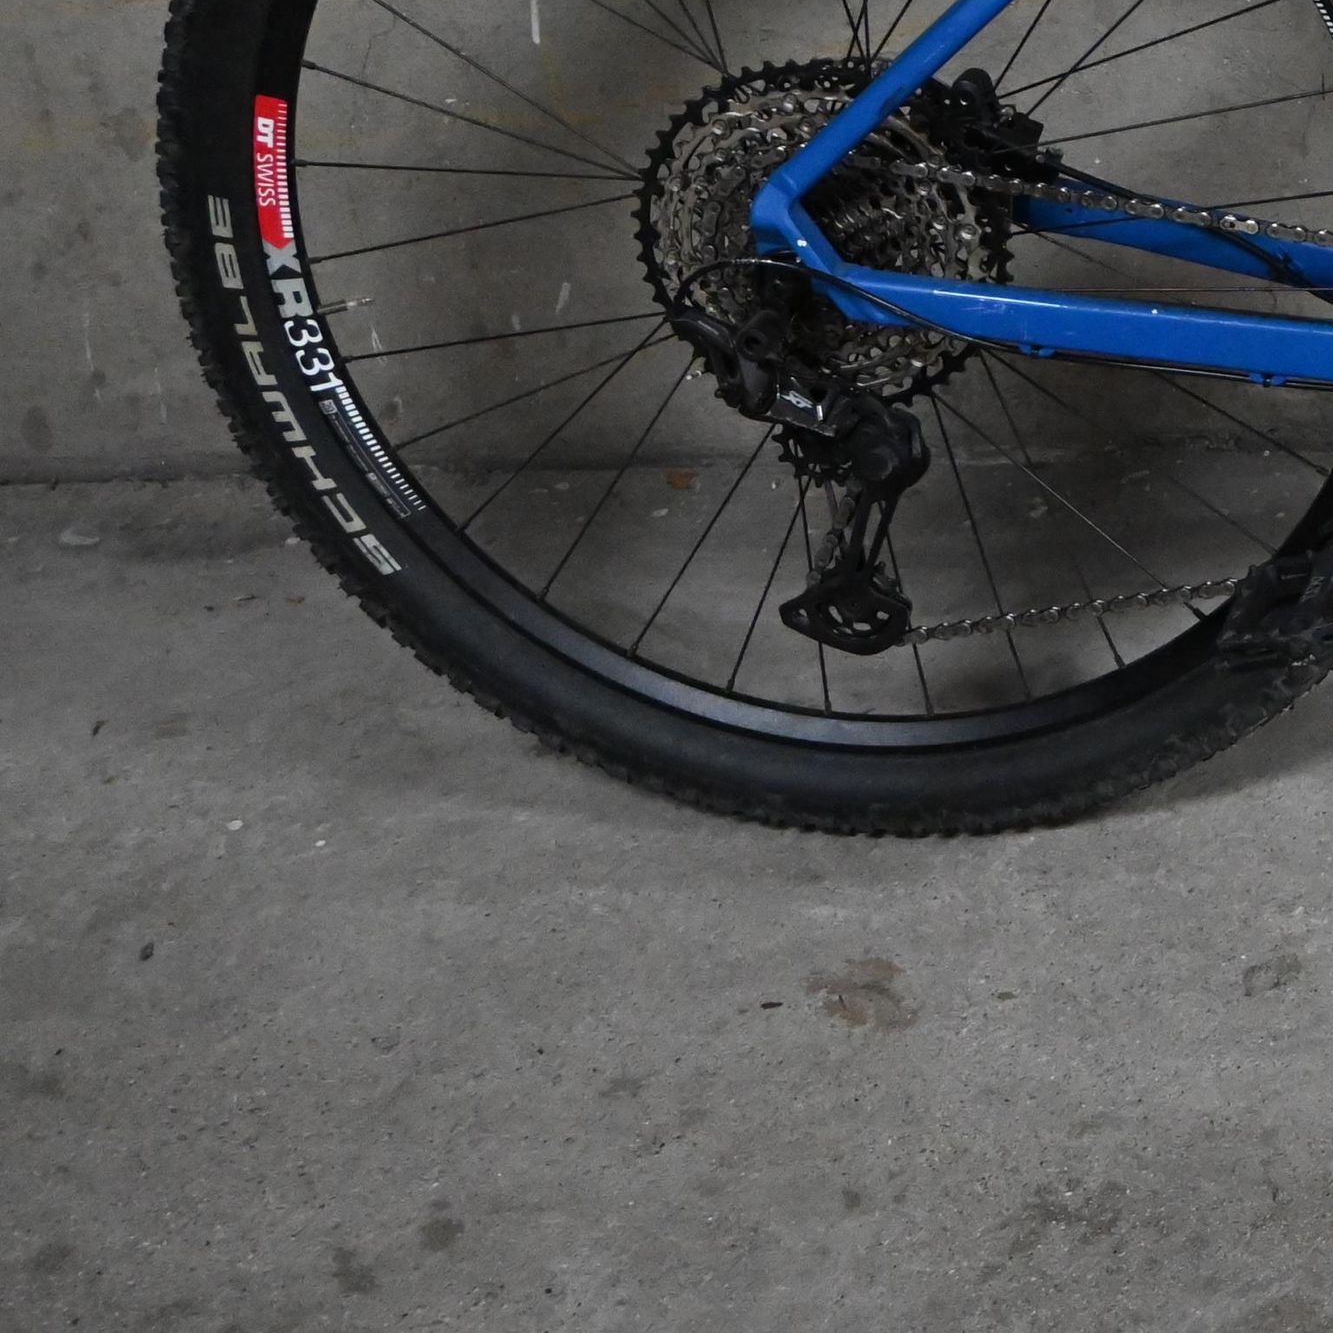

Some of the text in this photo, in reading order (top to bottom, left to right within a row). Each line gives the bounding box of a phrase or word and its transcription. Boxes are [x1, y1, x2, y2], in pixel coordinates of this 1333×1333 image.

[257, 116, 276, 207] DT SWISS
[207, 195, 402, 575] SCHWALBE
